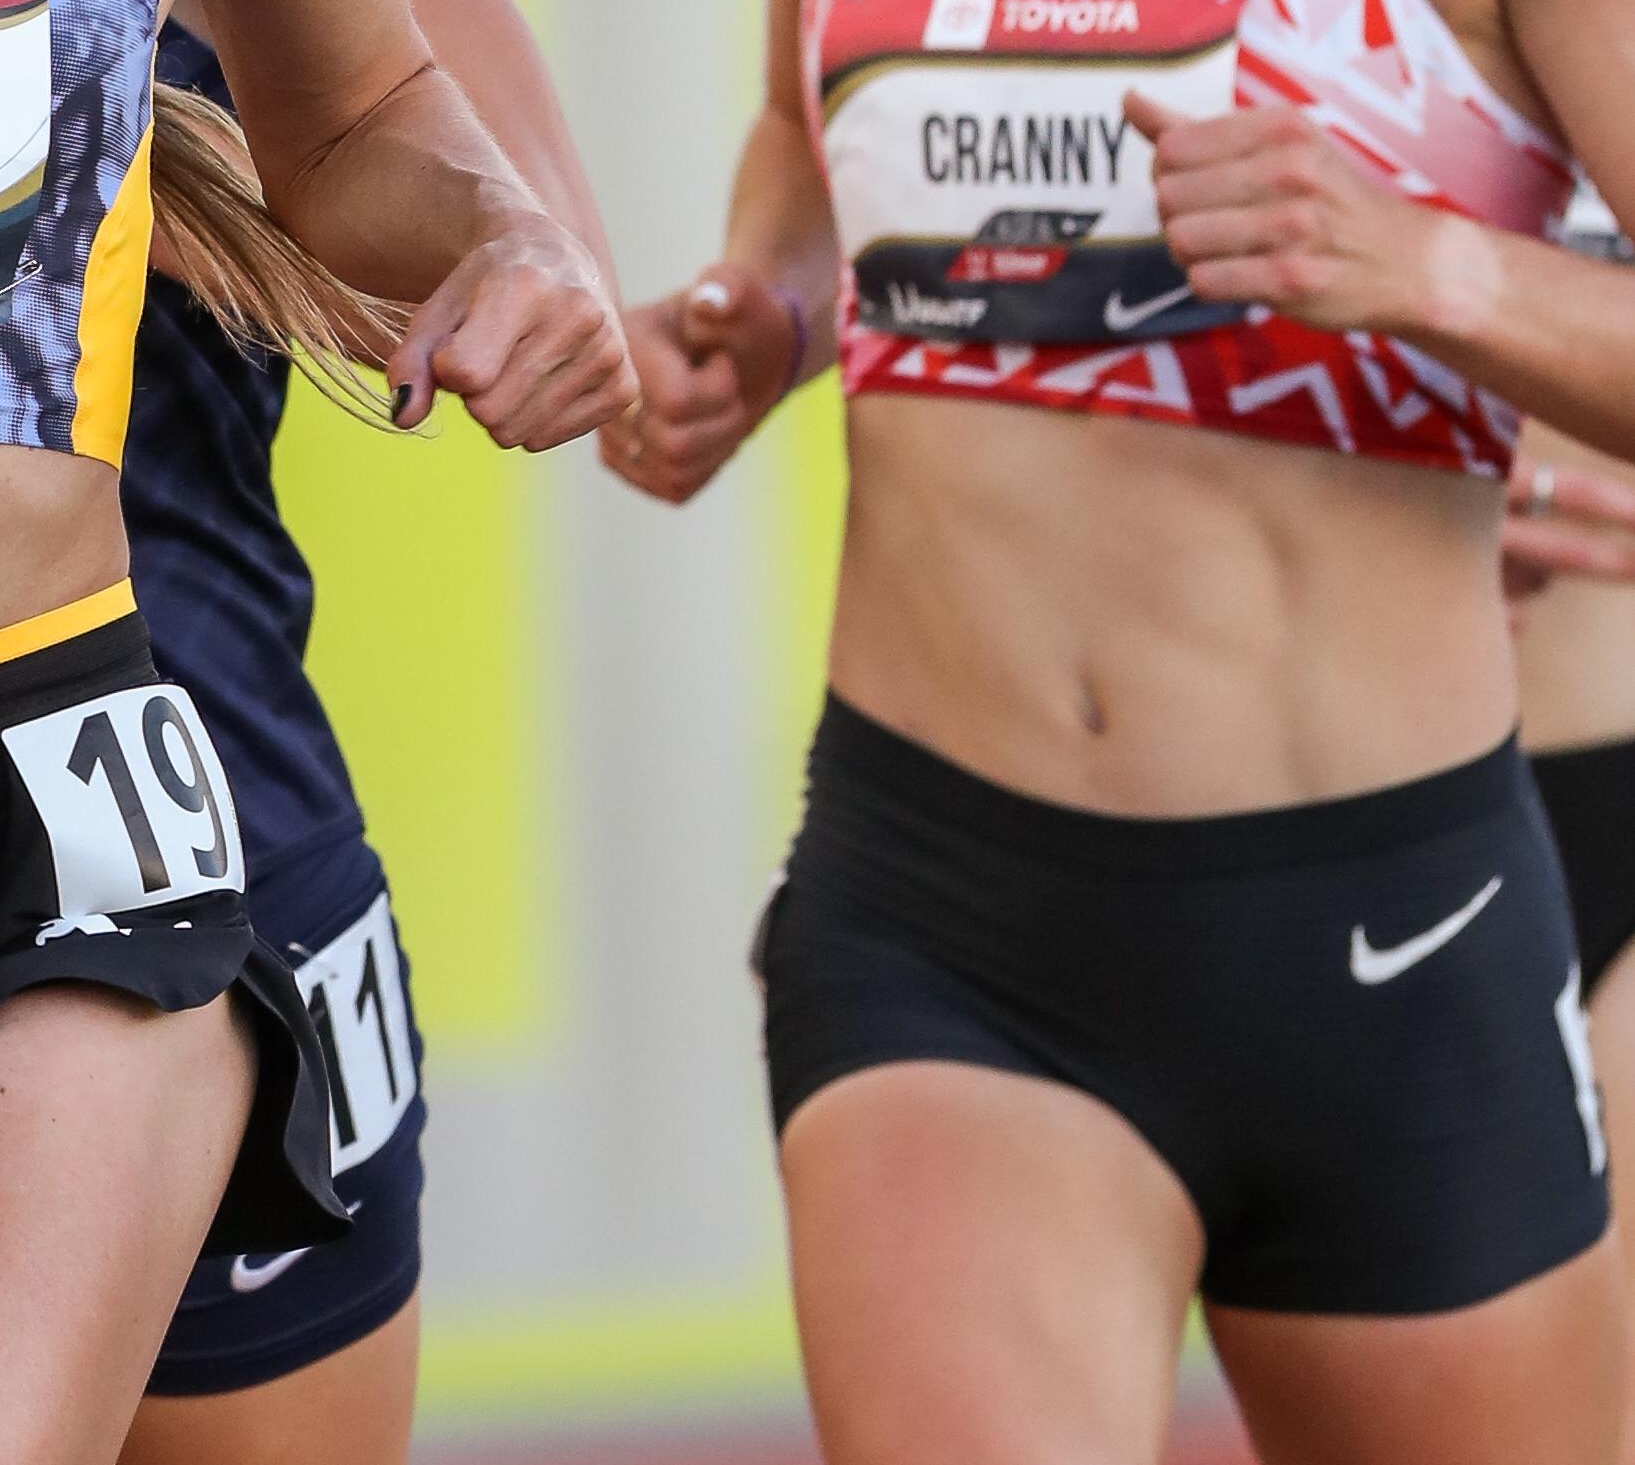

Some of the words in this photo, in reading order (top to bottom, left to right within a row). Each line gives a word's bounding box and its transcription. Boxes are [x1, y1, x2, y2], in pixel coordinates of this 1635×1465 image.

[923, 115, 1128, 183] CRANNY
[67, 696, 227, 894] 19
[308, 938, 398, 1149] 11
